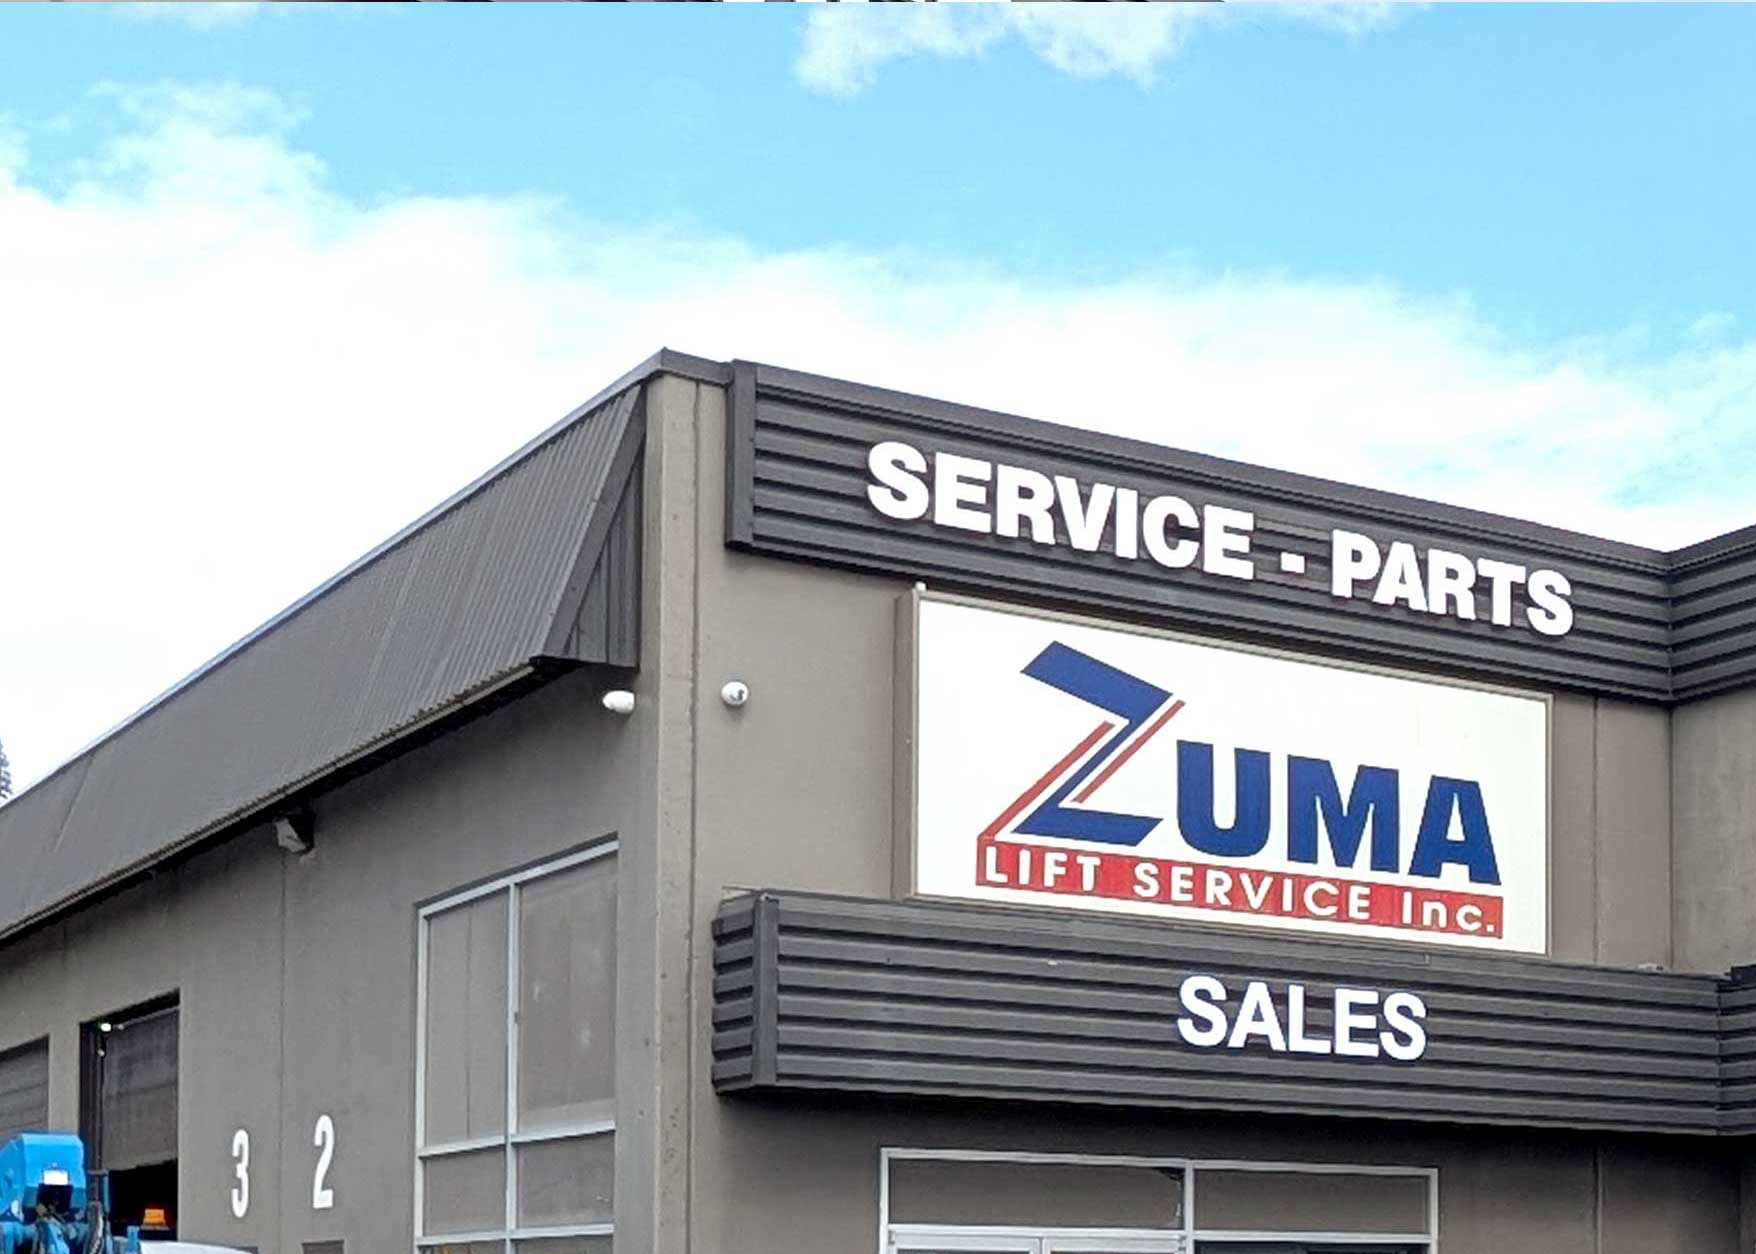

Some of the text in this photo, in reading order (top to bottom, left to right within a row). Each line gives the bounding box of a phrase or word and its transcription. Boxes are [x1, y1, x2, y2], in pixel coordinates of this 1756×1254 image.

[866, 441, 1256, 580] SERVICE
[1331, 529, 1576, 638] PARTS
[1008, 639, 1503, 887] ZUMA
[983, 844, 1104, 894] LIFT
[1132, 860, 1371, 922] SERVICE
[1176, 974, 1429, 1062] SALES
[231, 1128, 250, 1220] 3
[312, 1114, 336, 1210] 2
